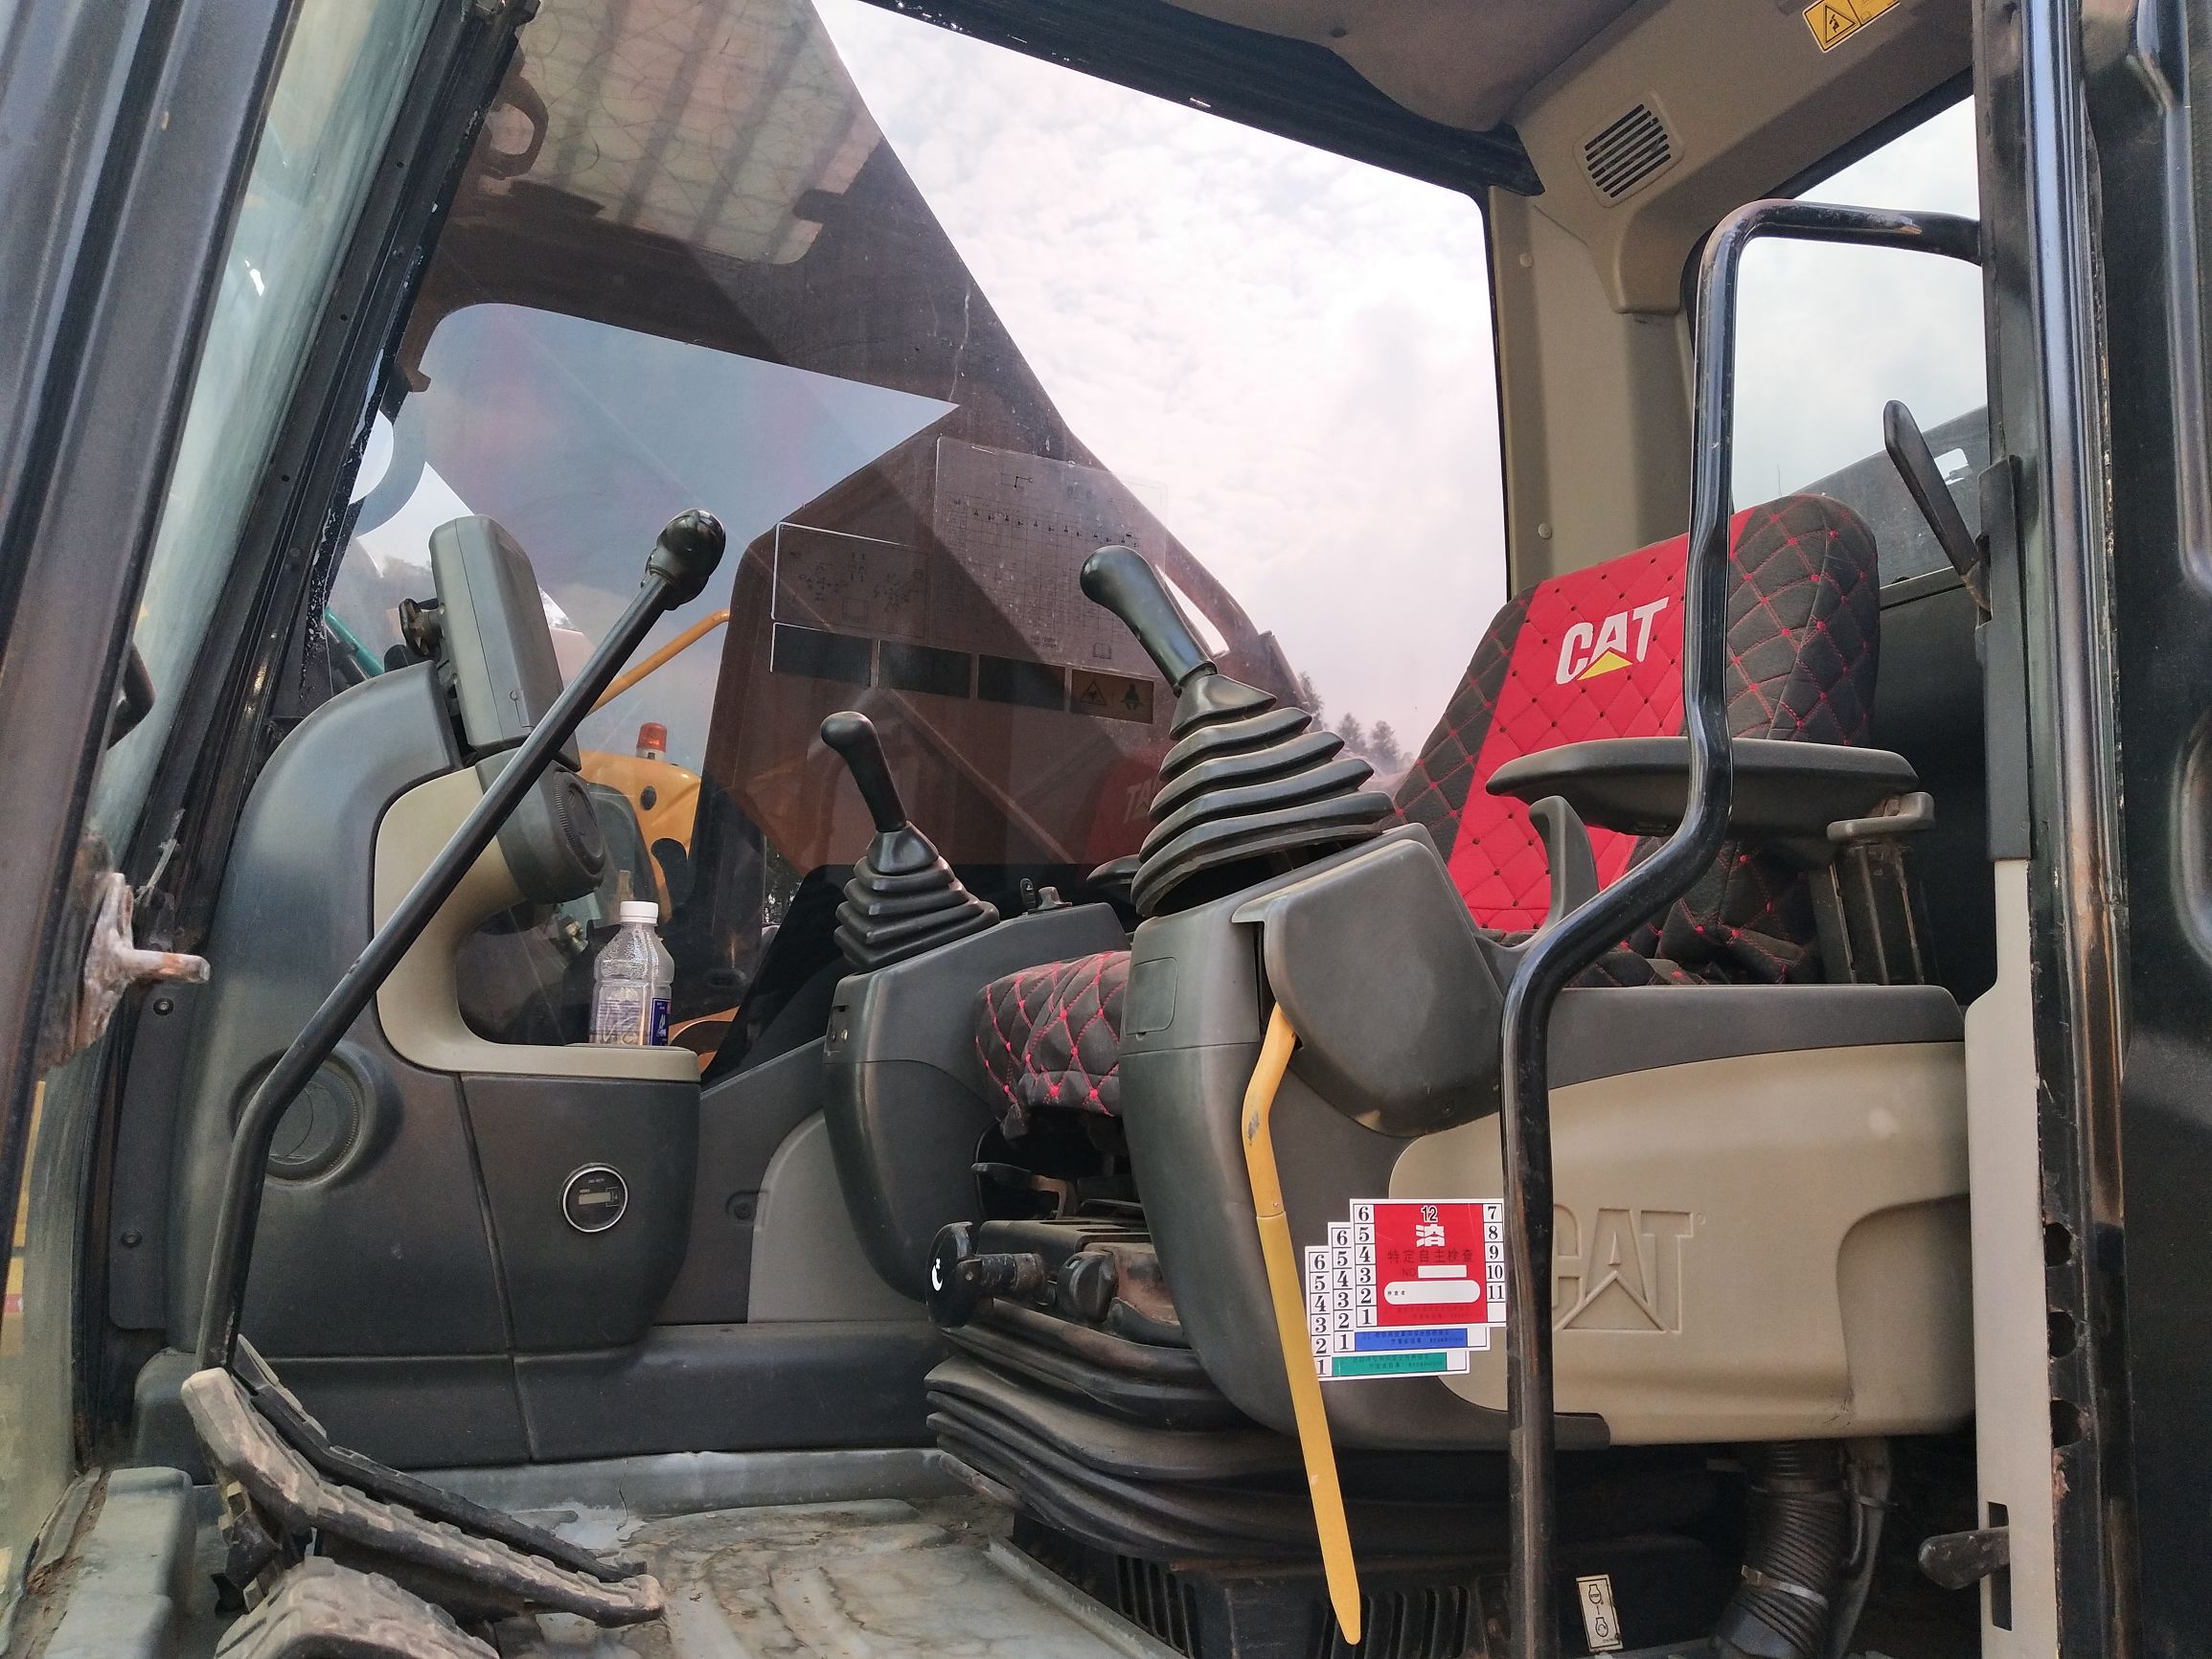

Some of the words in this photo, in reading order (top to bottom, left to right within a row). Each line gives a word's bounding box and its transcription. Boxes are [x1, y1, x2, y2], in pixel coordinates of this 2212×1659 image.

[1556, 596, 1670, 685] CAT
[1359, 1207, 1369, 1220] 6
[1421, 1205, 1438, 1222] 12
[1488, 1206, 1496, 1219] 7
[1337, 1231, 1347, 1245] 6
[1359, 1227, 1369, 1241] 5
[1489, 1226, 1497, 1239] 8
[1337, 1251, 1347, 1265] 5
[1359, 1247, 1370, 1261] 4
[1490, 1245, 1498, 1259] 9
[1314, 1255, 1325, 1269] 6
[1337, 1271, 1348, 1286] 4
[1360, 1268, 1370, 1283] 3
[1488, 1265, 1502, 1279] 10
[1315, 1276, 1325, 1290] 5
[1338, 1292, 1349, 1307] 3
[1361, 1288, 1371, 1304] 2
[1490, 1285, 1503, 1299] 11
[1315, 1296, 1326, 1311] 4
[1339, 1313, 1349, 1329] 2
[1363, 1309, 1370, 1324] 1
[1315, 1317, 1326, 1332] 3
[1316, 1338, 1326, 1353] 2
[1341, 1334, 1347, 1350] 1
[1318, 1359, 1325, 1375] 1
